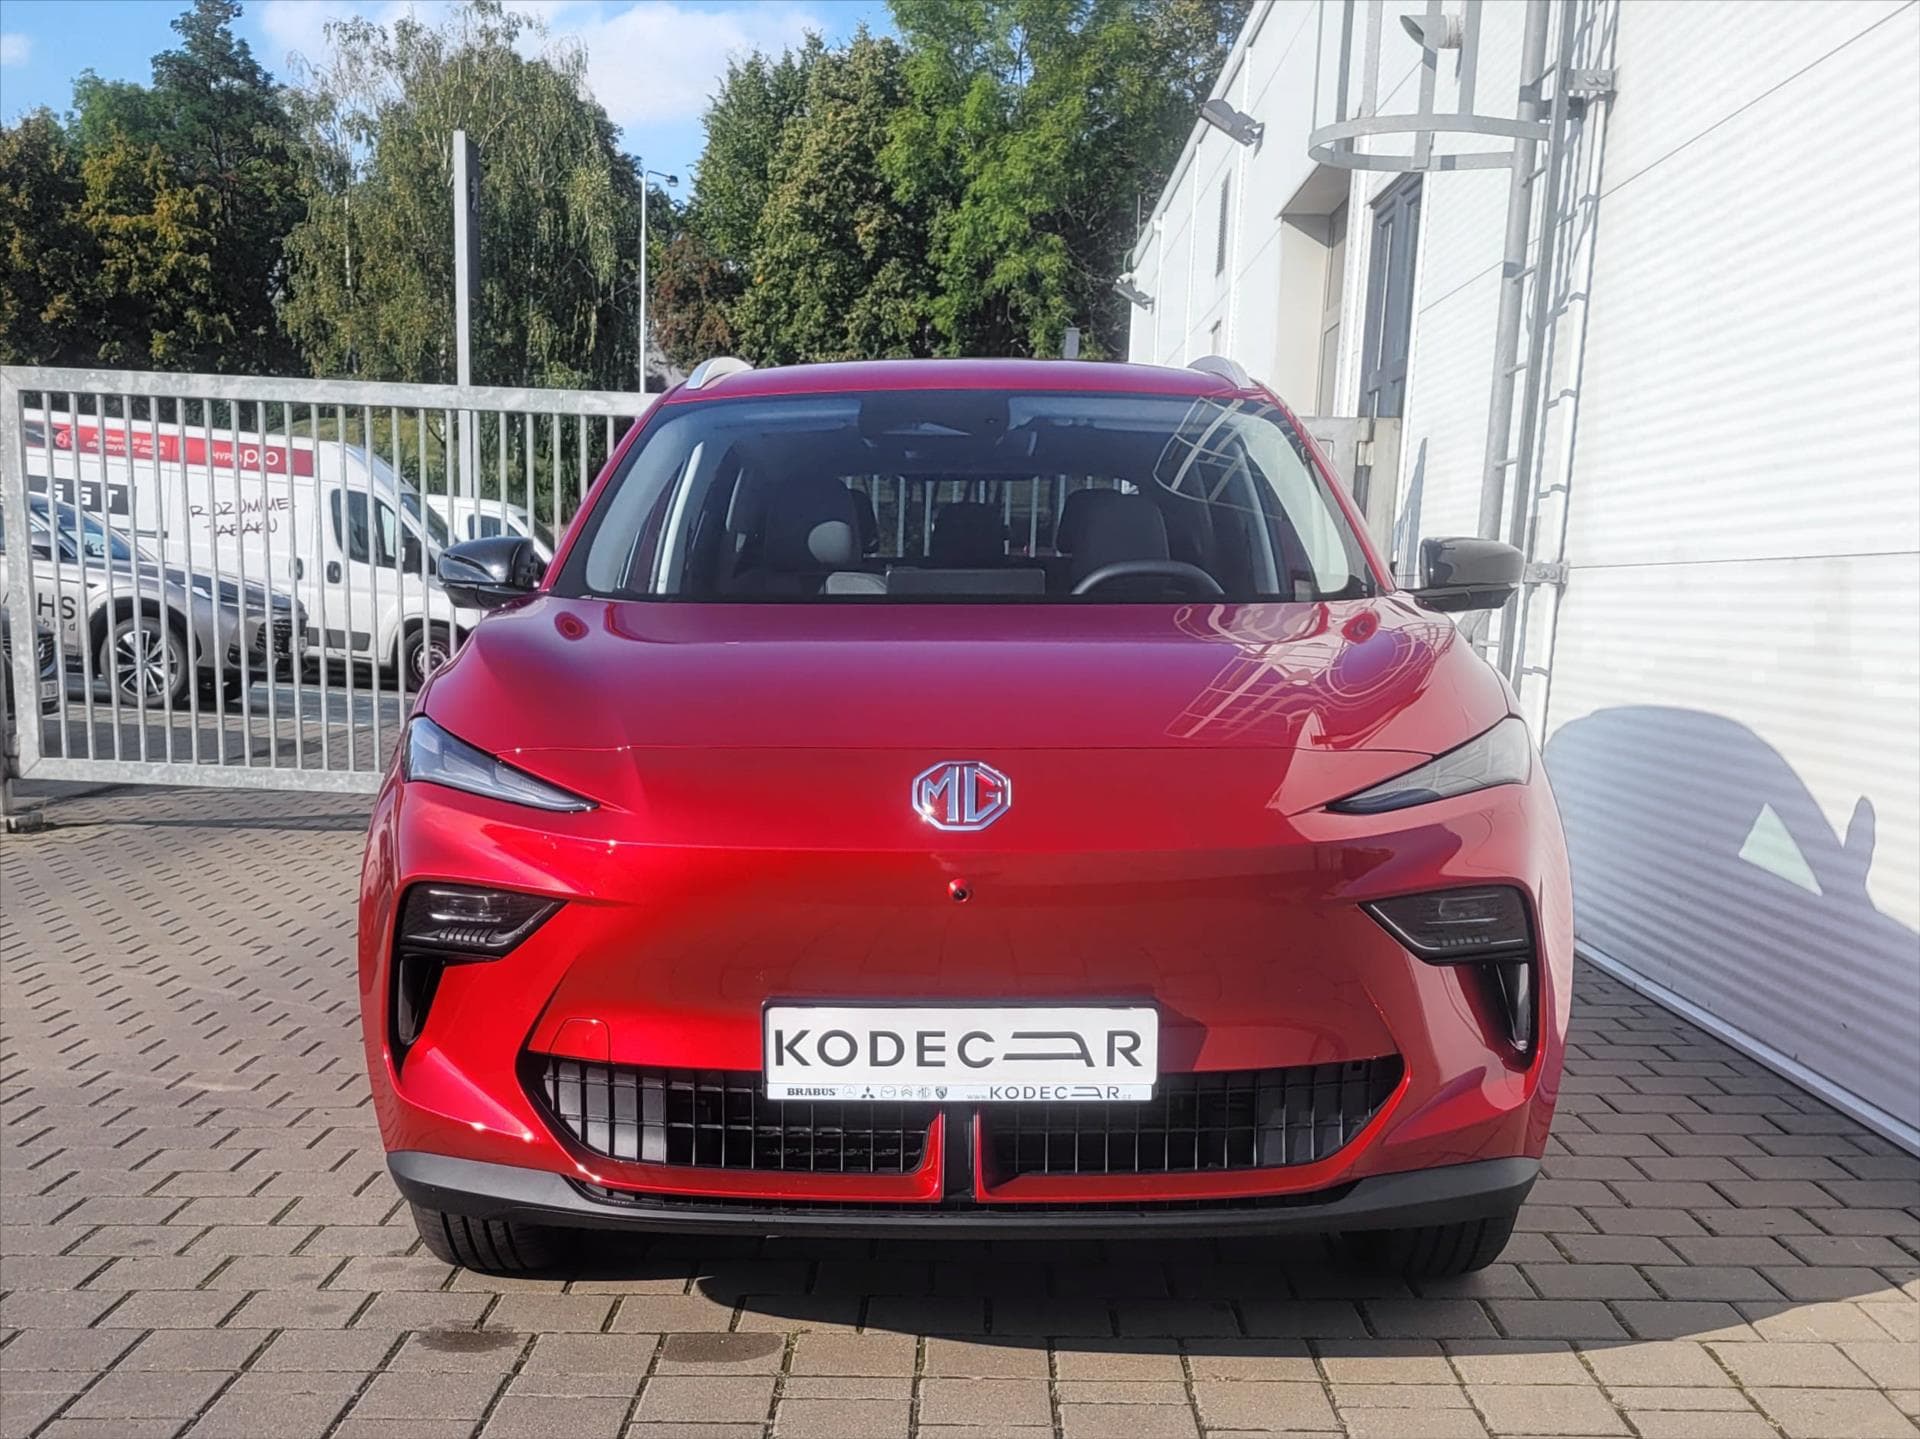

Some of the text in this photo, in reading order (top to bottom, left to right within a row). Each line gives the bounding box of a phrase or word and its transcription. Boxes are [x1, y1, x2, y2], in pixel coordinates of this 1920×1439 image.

[243, 449, 279, 468] po
[921, 765, 1002, 824] MG
[775, 1029, 1143, 1068] KODECAR
[787, 1087, 836, 1097] BRABUS
